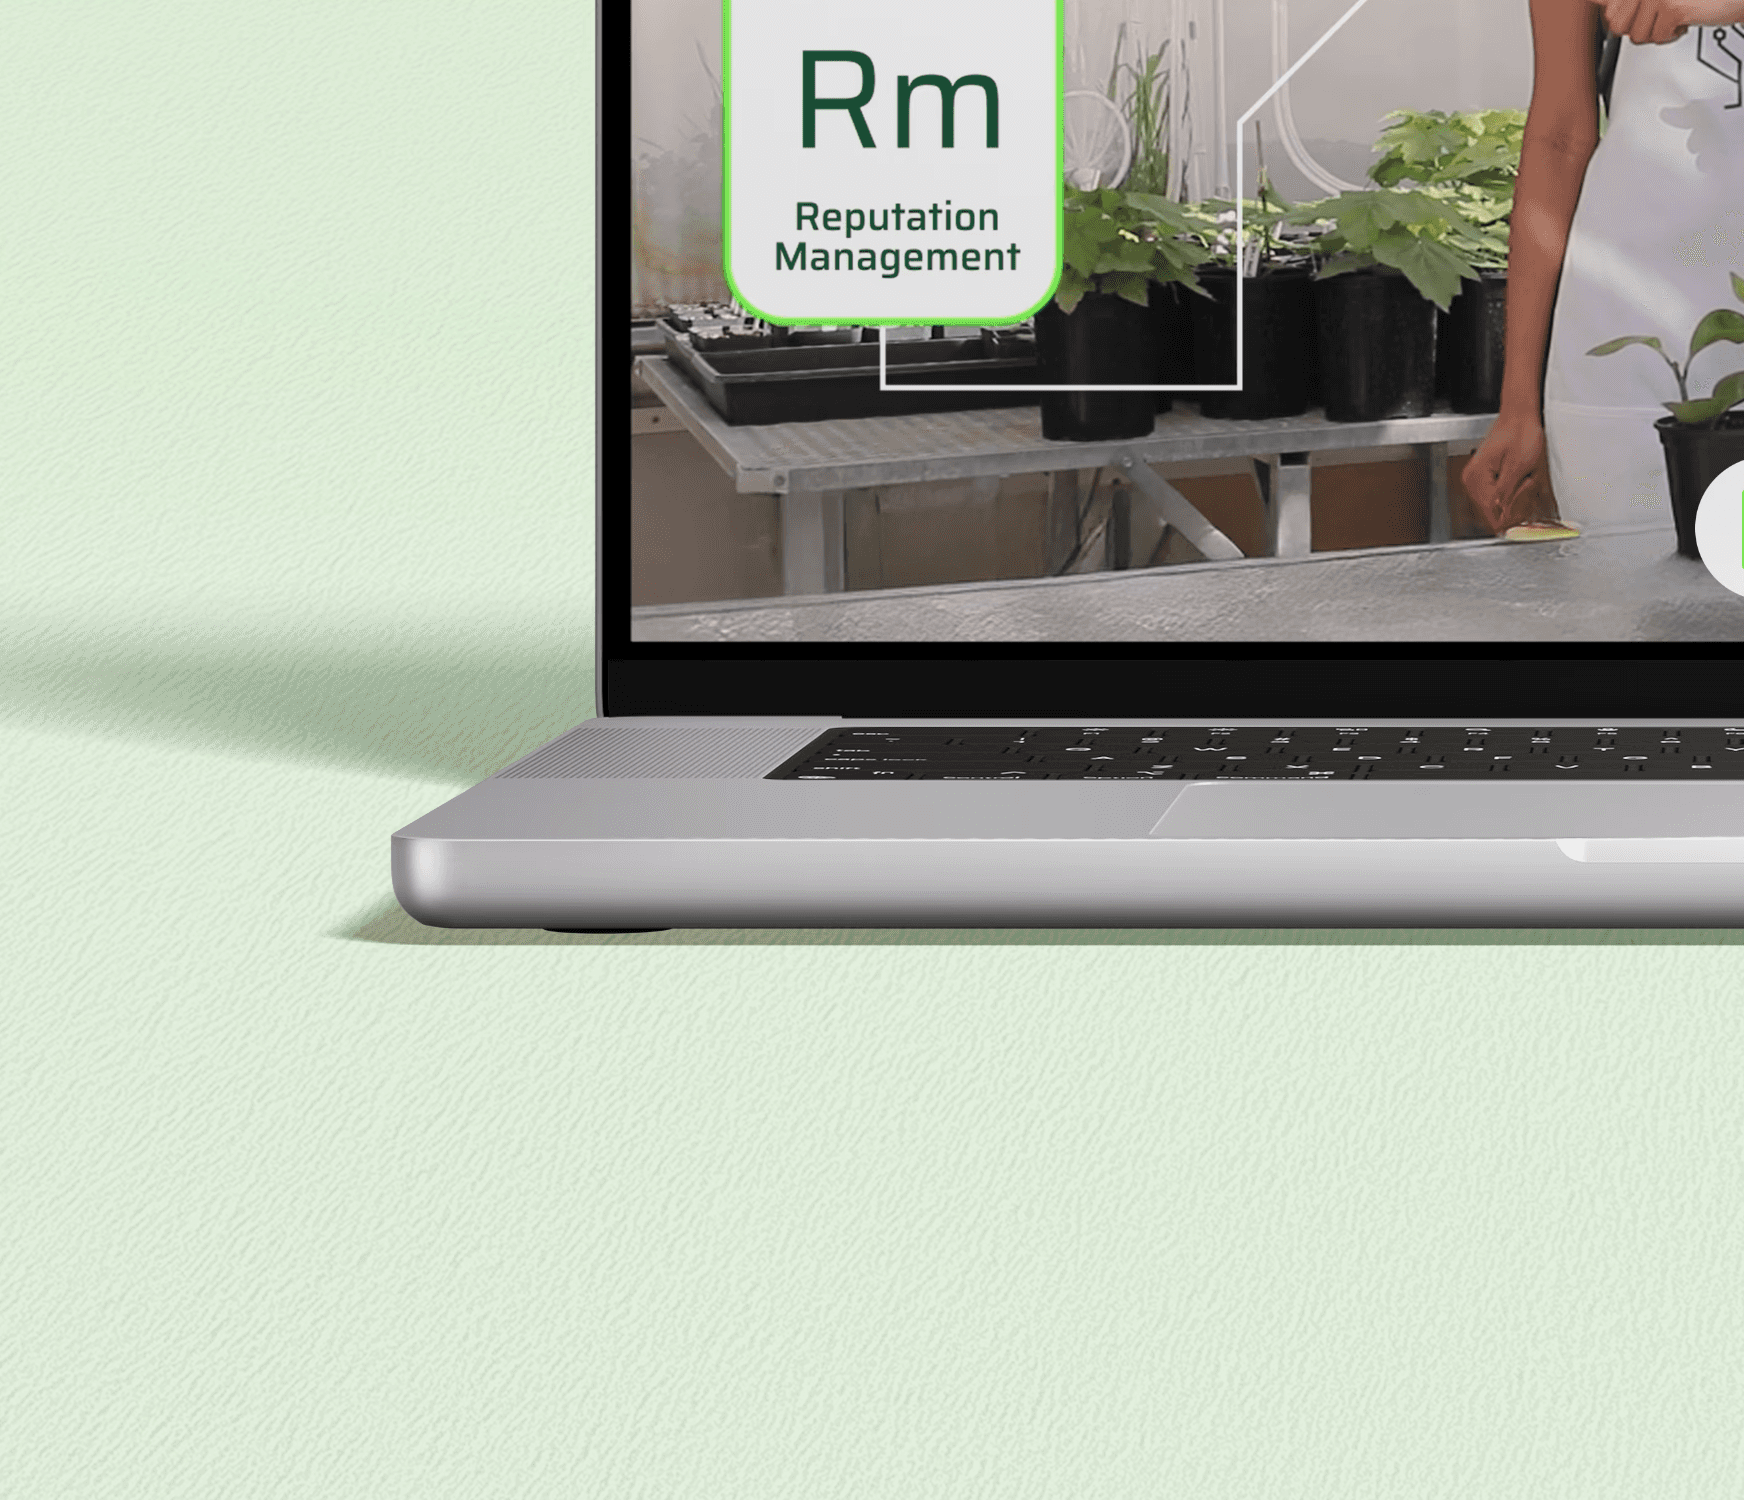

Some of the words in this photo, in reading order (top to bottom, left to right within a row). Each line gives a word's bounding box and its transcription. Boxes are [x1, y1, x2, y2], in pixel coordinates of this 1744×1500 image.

[802, 49, 999, 149] Rm
[796, 199, 999, 236] Reputation
[775, 241, 1021, 279] Management
